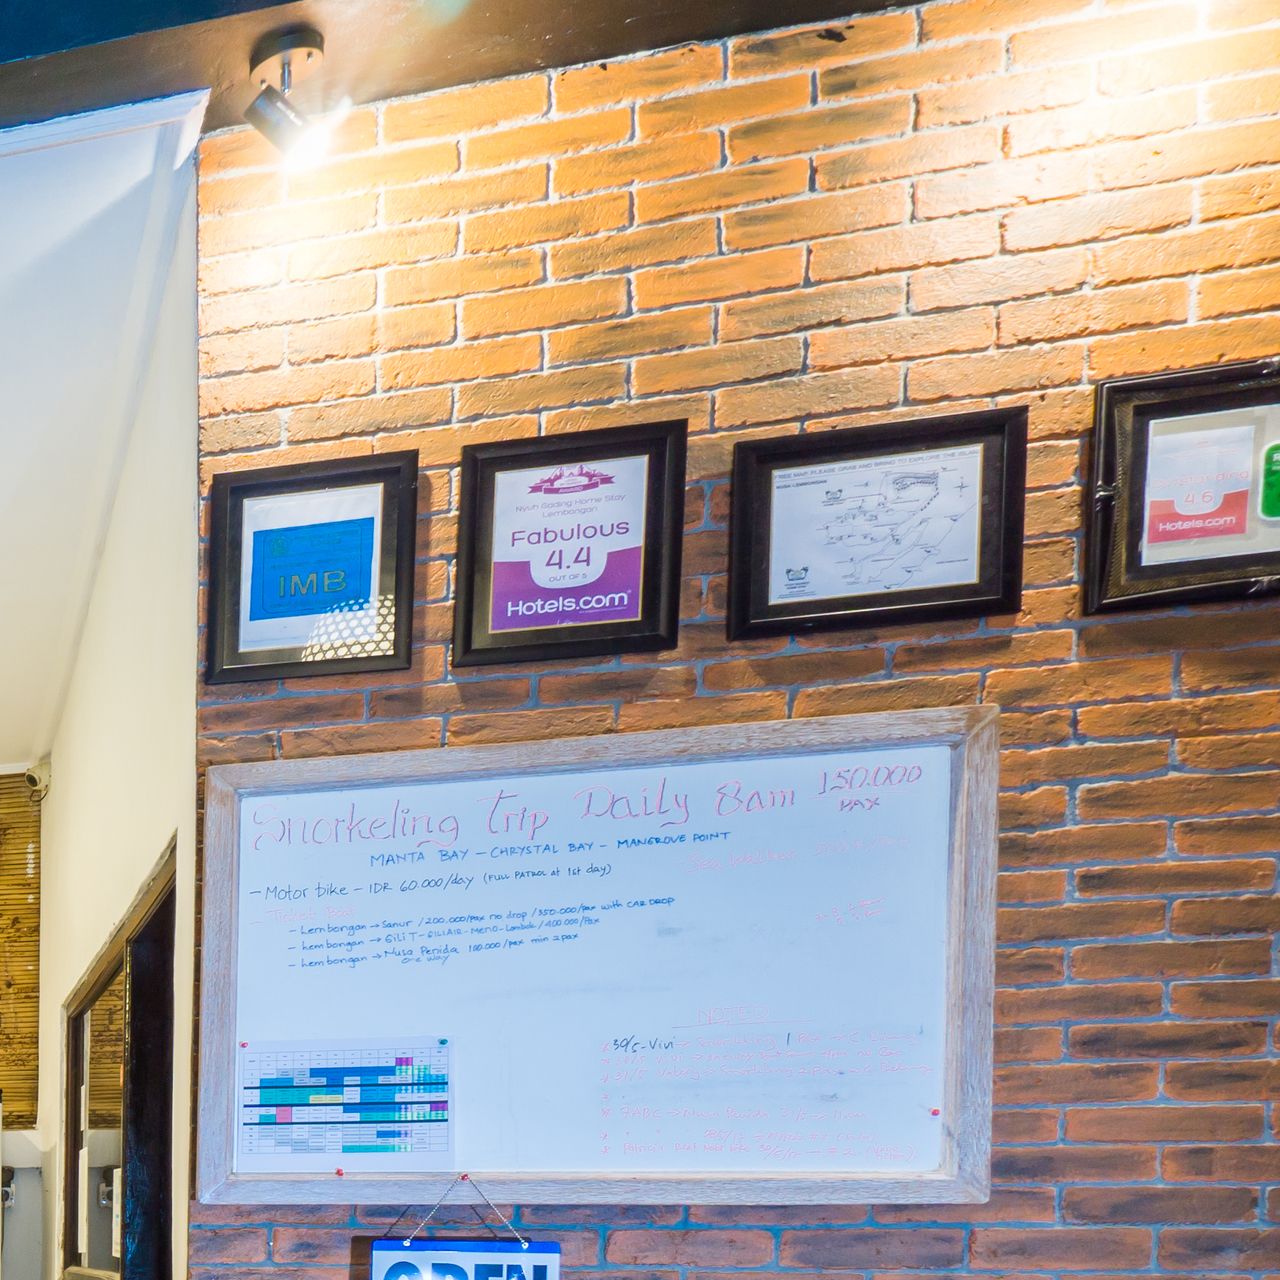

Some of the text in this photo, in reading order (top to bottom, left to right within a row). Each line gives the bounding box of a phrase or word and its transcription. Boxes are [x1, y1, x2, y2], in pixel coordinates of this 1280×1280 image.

[542, 506, 598, 518] Lembongan
[575, 496, 602, 506] Home
[604, 494, 627, 503] Stay
[511, 521, 630, 547] Fabulous
[1158, 515, 1236, 532] Hotels.com
[545, 546, 591, 570] 4.4
[278, 570, 347, 598] IMB
[548, 575, 567, 583] OUT
[506, 592, 628, 617] Hotels.com
[253, 799, 459, 851] Snorkeling
[574, 777, 690, 827] Daily
[716, 780, 795, 817] 8am
[370, 851, 425, 867] MANTA
[439, 847, 469, 863] BAY
[490, 844, 559, 859] CHRYSTAL
[568, 841, 594, 853] BAY
[692, 831, 731, 844] POINT
[265, 885, 308, 901] Motor
[315, 882, 349, 898] bike
[369, 882, 393, 894] IDR
[550, 867, 560, 877] at
[382, 920, 412, 929] Sanur
[506, 911, 527, 920] drop
[601, 900, 623, 910] with
[420, 944, 460, 956] Penida
[531, 936, 549, 944] min
